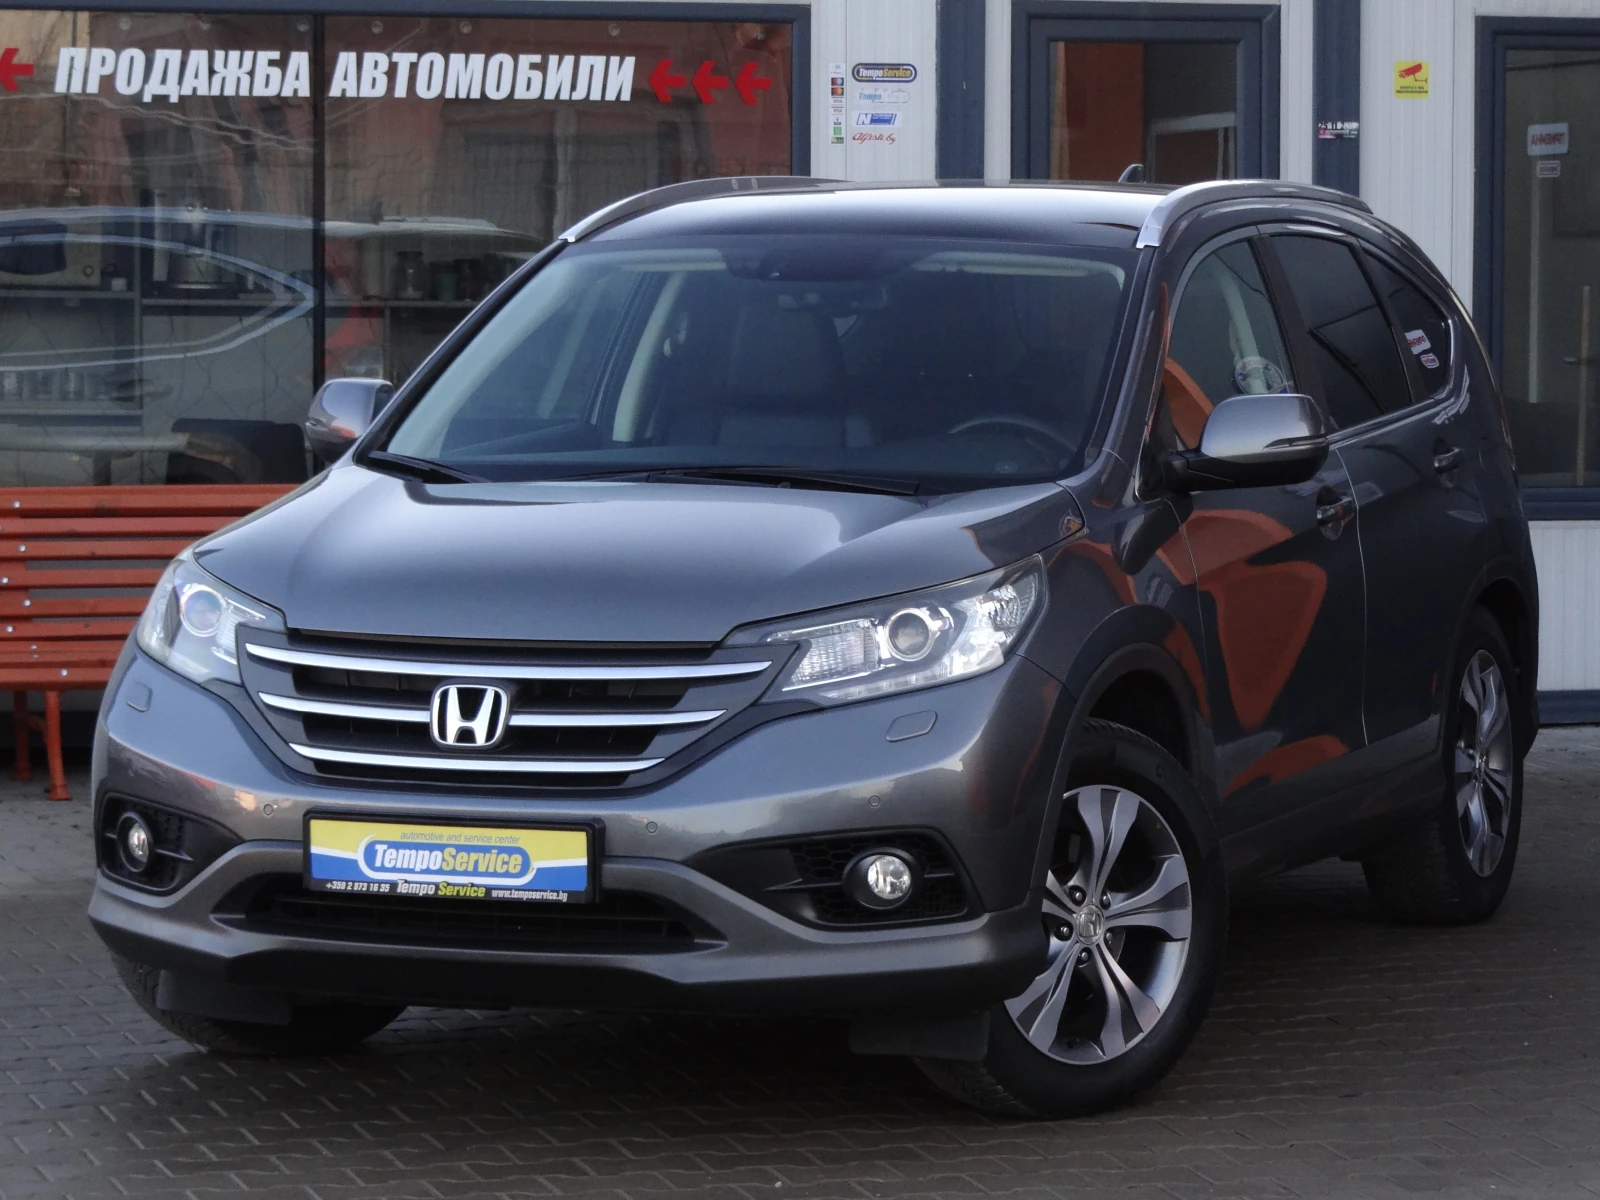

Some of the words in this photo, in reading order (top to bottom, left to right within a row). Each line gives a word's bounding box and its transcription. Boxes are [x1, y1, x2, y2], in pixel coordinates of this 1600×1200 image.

[54, 47, 311, 104] ПРОДАЖБА
[328, 51, 636, 102] АВТОМОБИЛИ
[859, 68, 911, 80] TempoService
[400, 831, 445, 841] automotive
[446, 833, 462, 842] and
[463, 834, 493, 843] service
[494, 835, 521, 845] center
[374, 844, 523, 874] TempoService
[325, 881, 346, 890] +359
[346, 882, 352, 891] 2
[353, 882, 368, 892] 973
[369, 883, 379, 892] 16
[379, 883, 391, 893] 35
[396, 880, 436, 896] Tempo
[437, 882, 486, 898] Service
[491, 889, 568, 902] www.temposervice.bg
